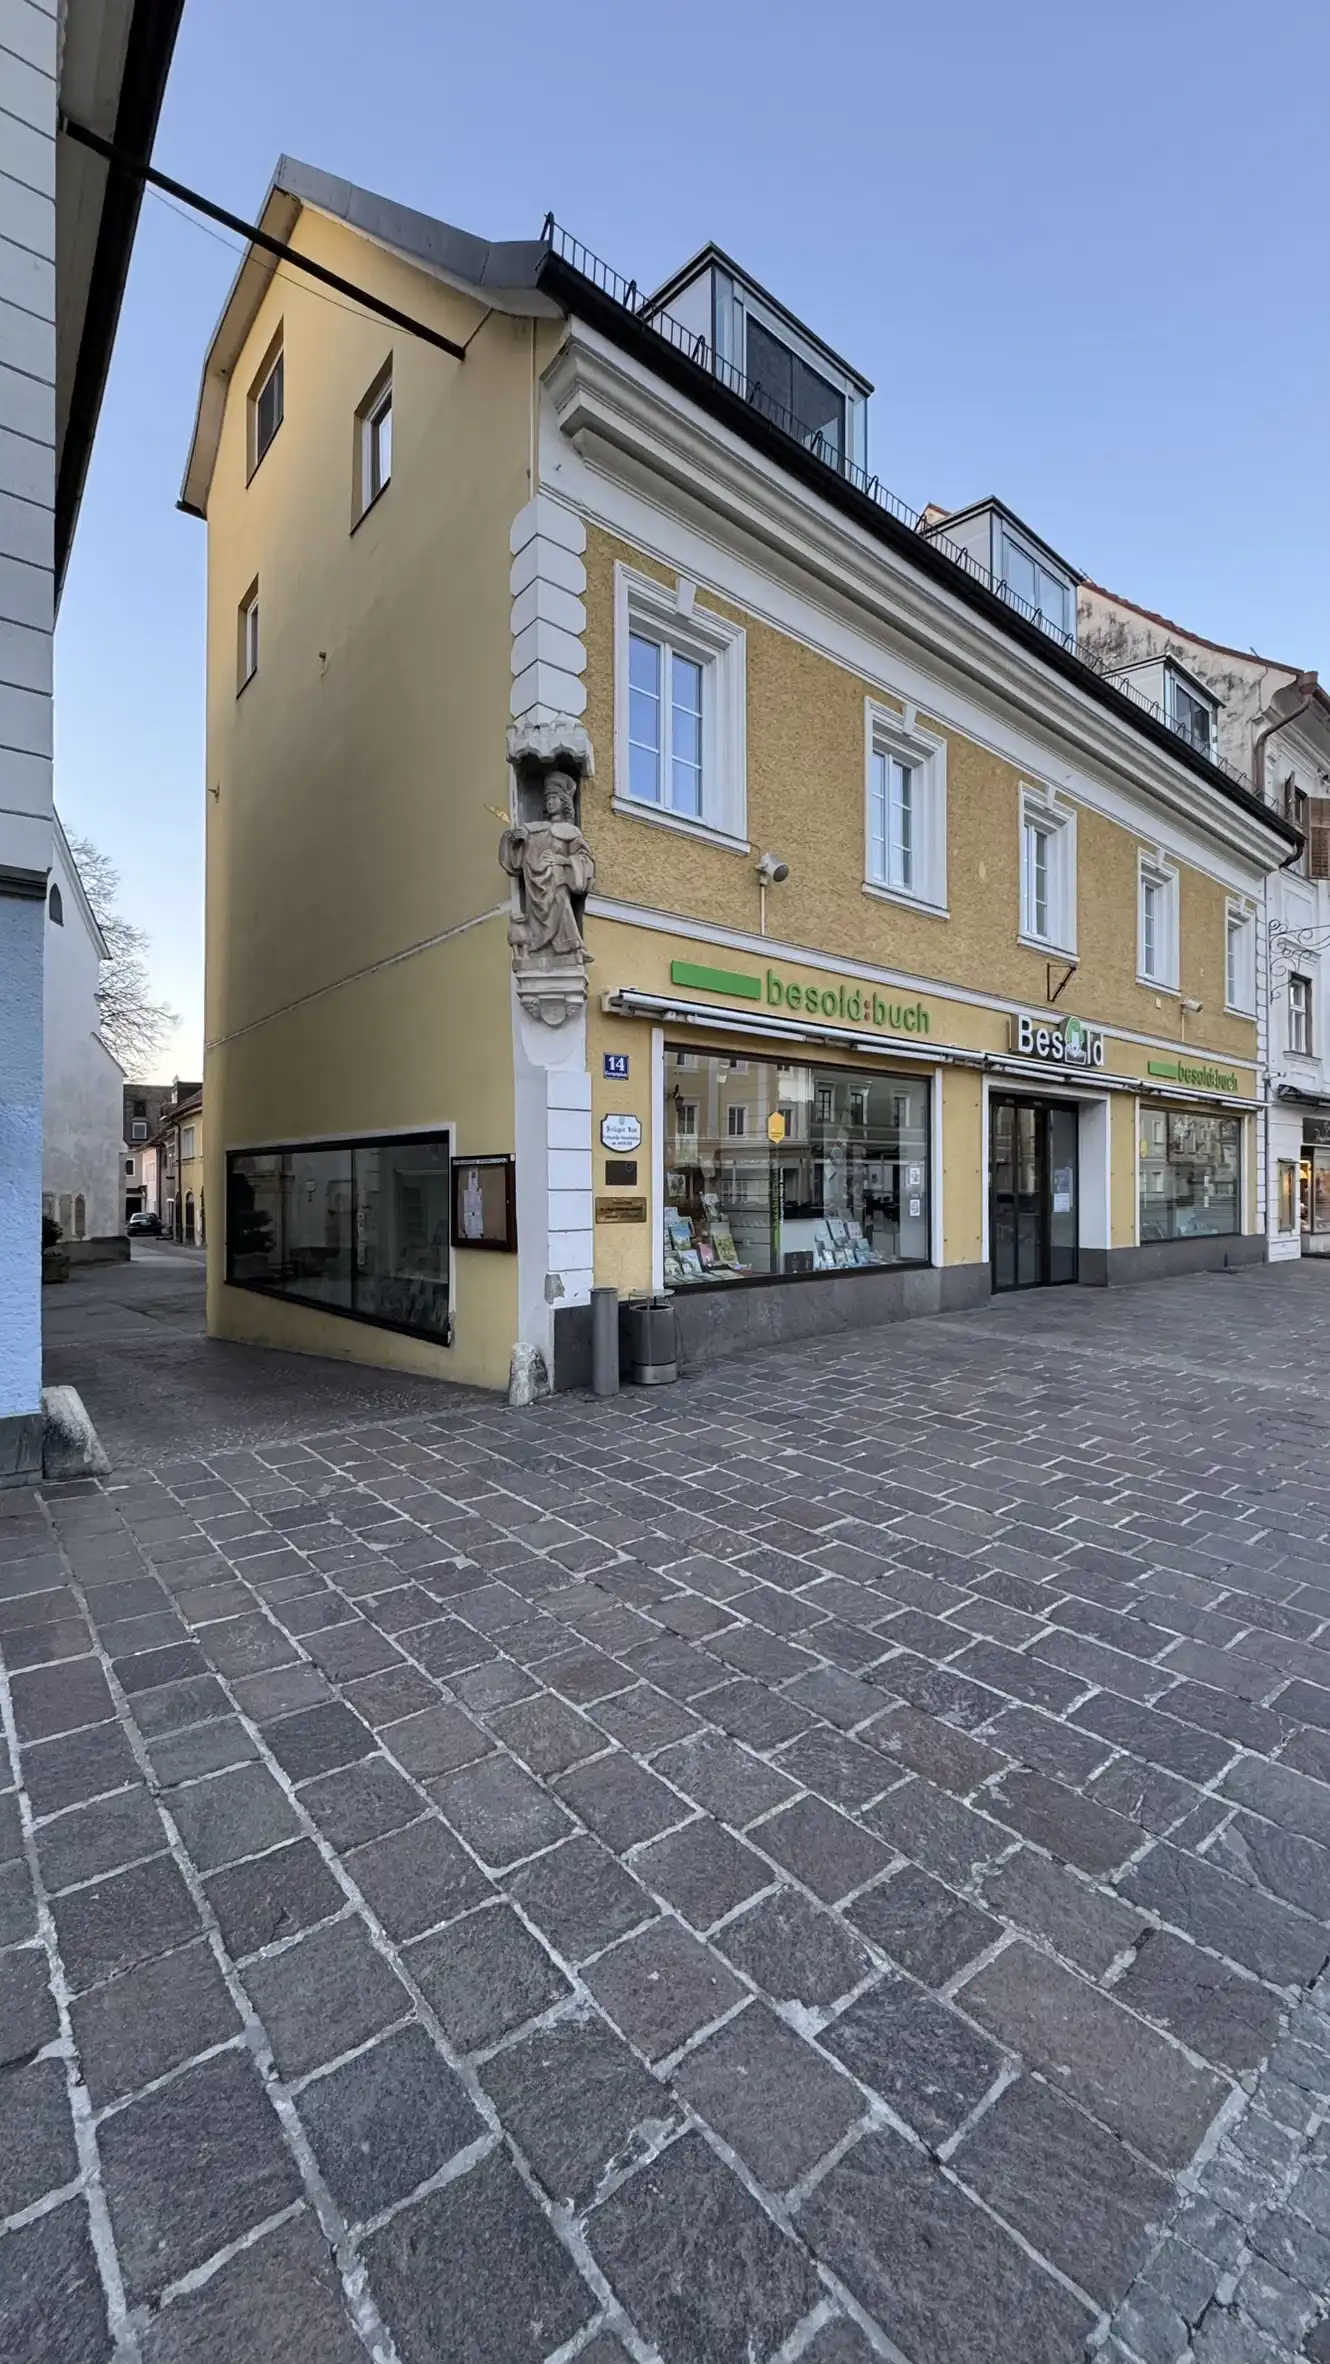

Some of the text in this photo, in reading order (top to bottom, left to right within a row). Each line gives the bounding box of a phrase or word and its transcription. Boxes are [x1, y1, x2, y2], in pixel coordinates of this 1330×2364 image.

[766, 968, 930, 1034] besold:buch
[608, 1056, 625, 1071] 14
[1177, 1060, 1238, 1091] besold:buch
